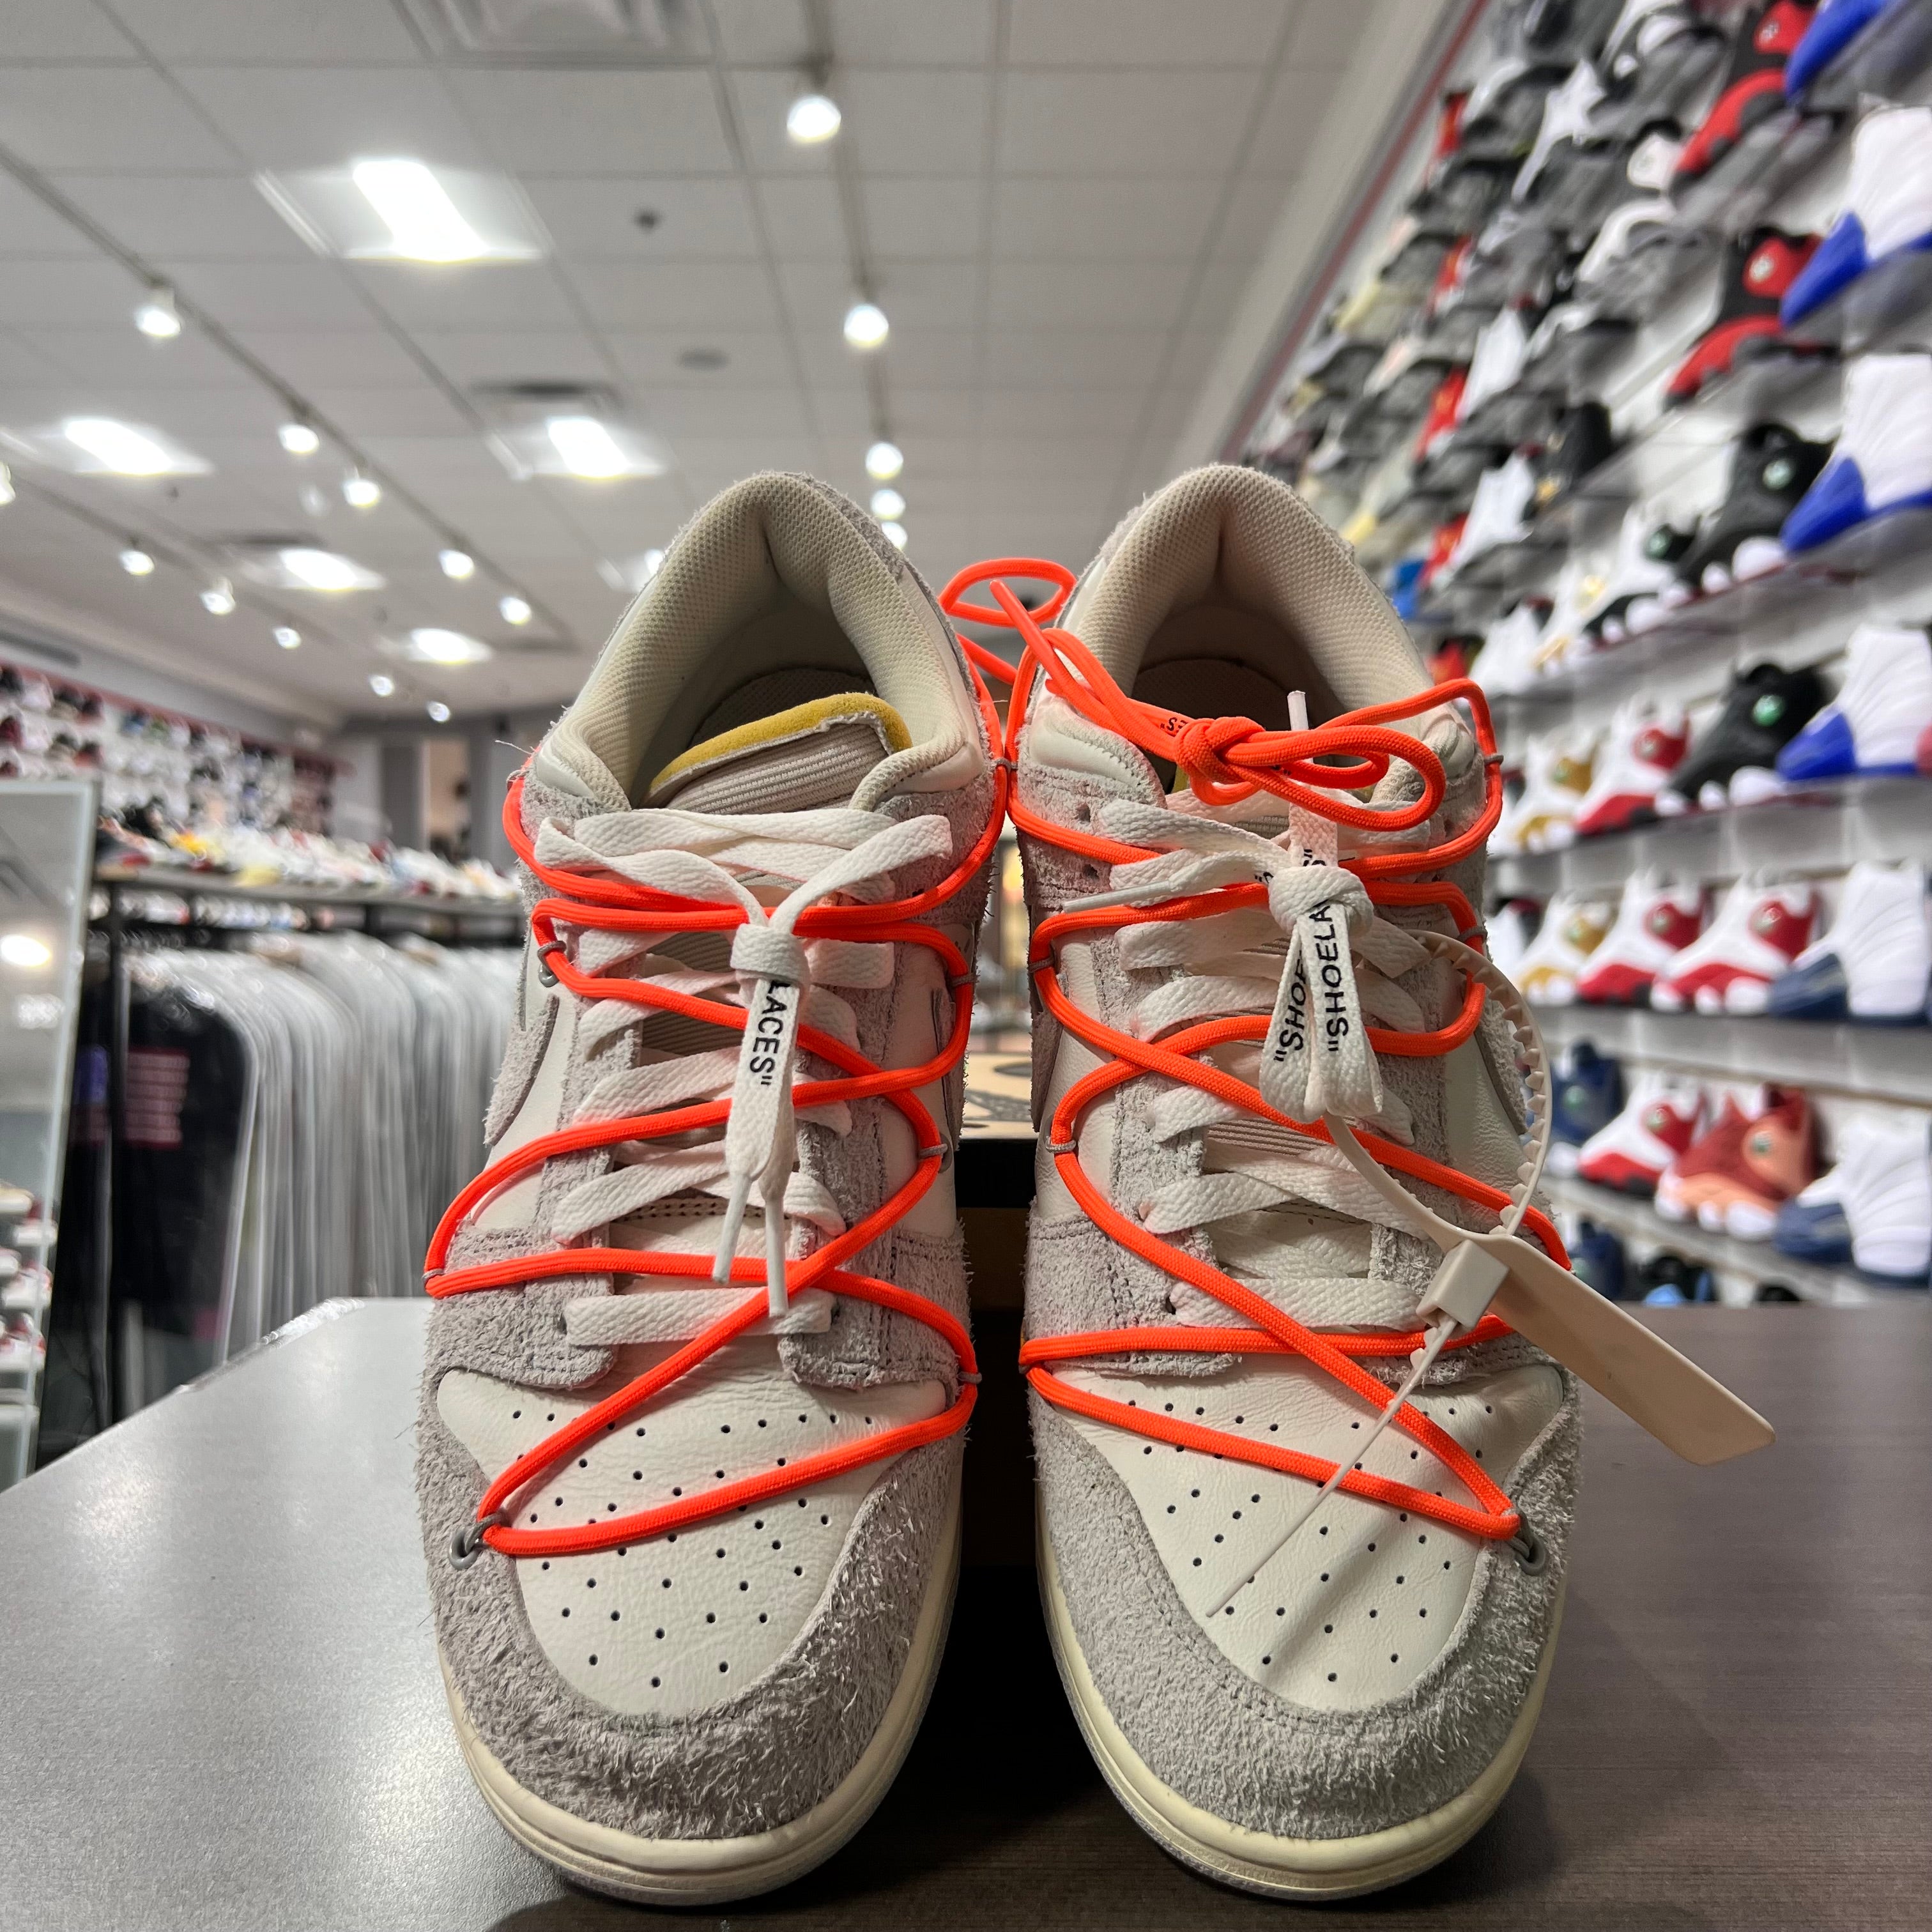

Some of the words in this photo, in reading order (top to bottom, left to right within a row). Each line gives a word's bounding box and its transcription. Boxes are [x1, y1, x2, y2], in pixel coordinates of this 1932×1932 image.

[1274, 949, 1306, 1061] "SHOE
[1310, 900, 1349, 1051] "SHOELA
[752, 980, 790, 1085] LACES"
